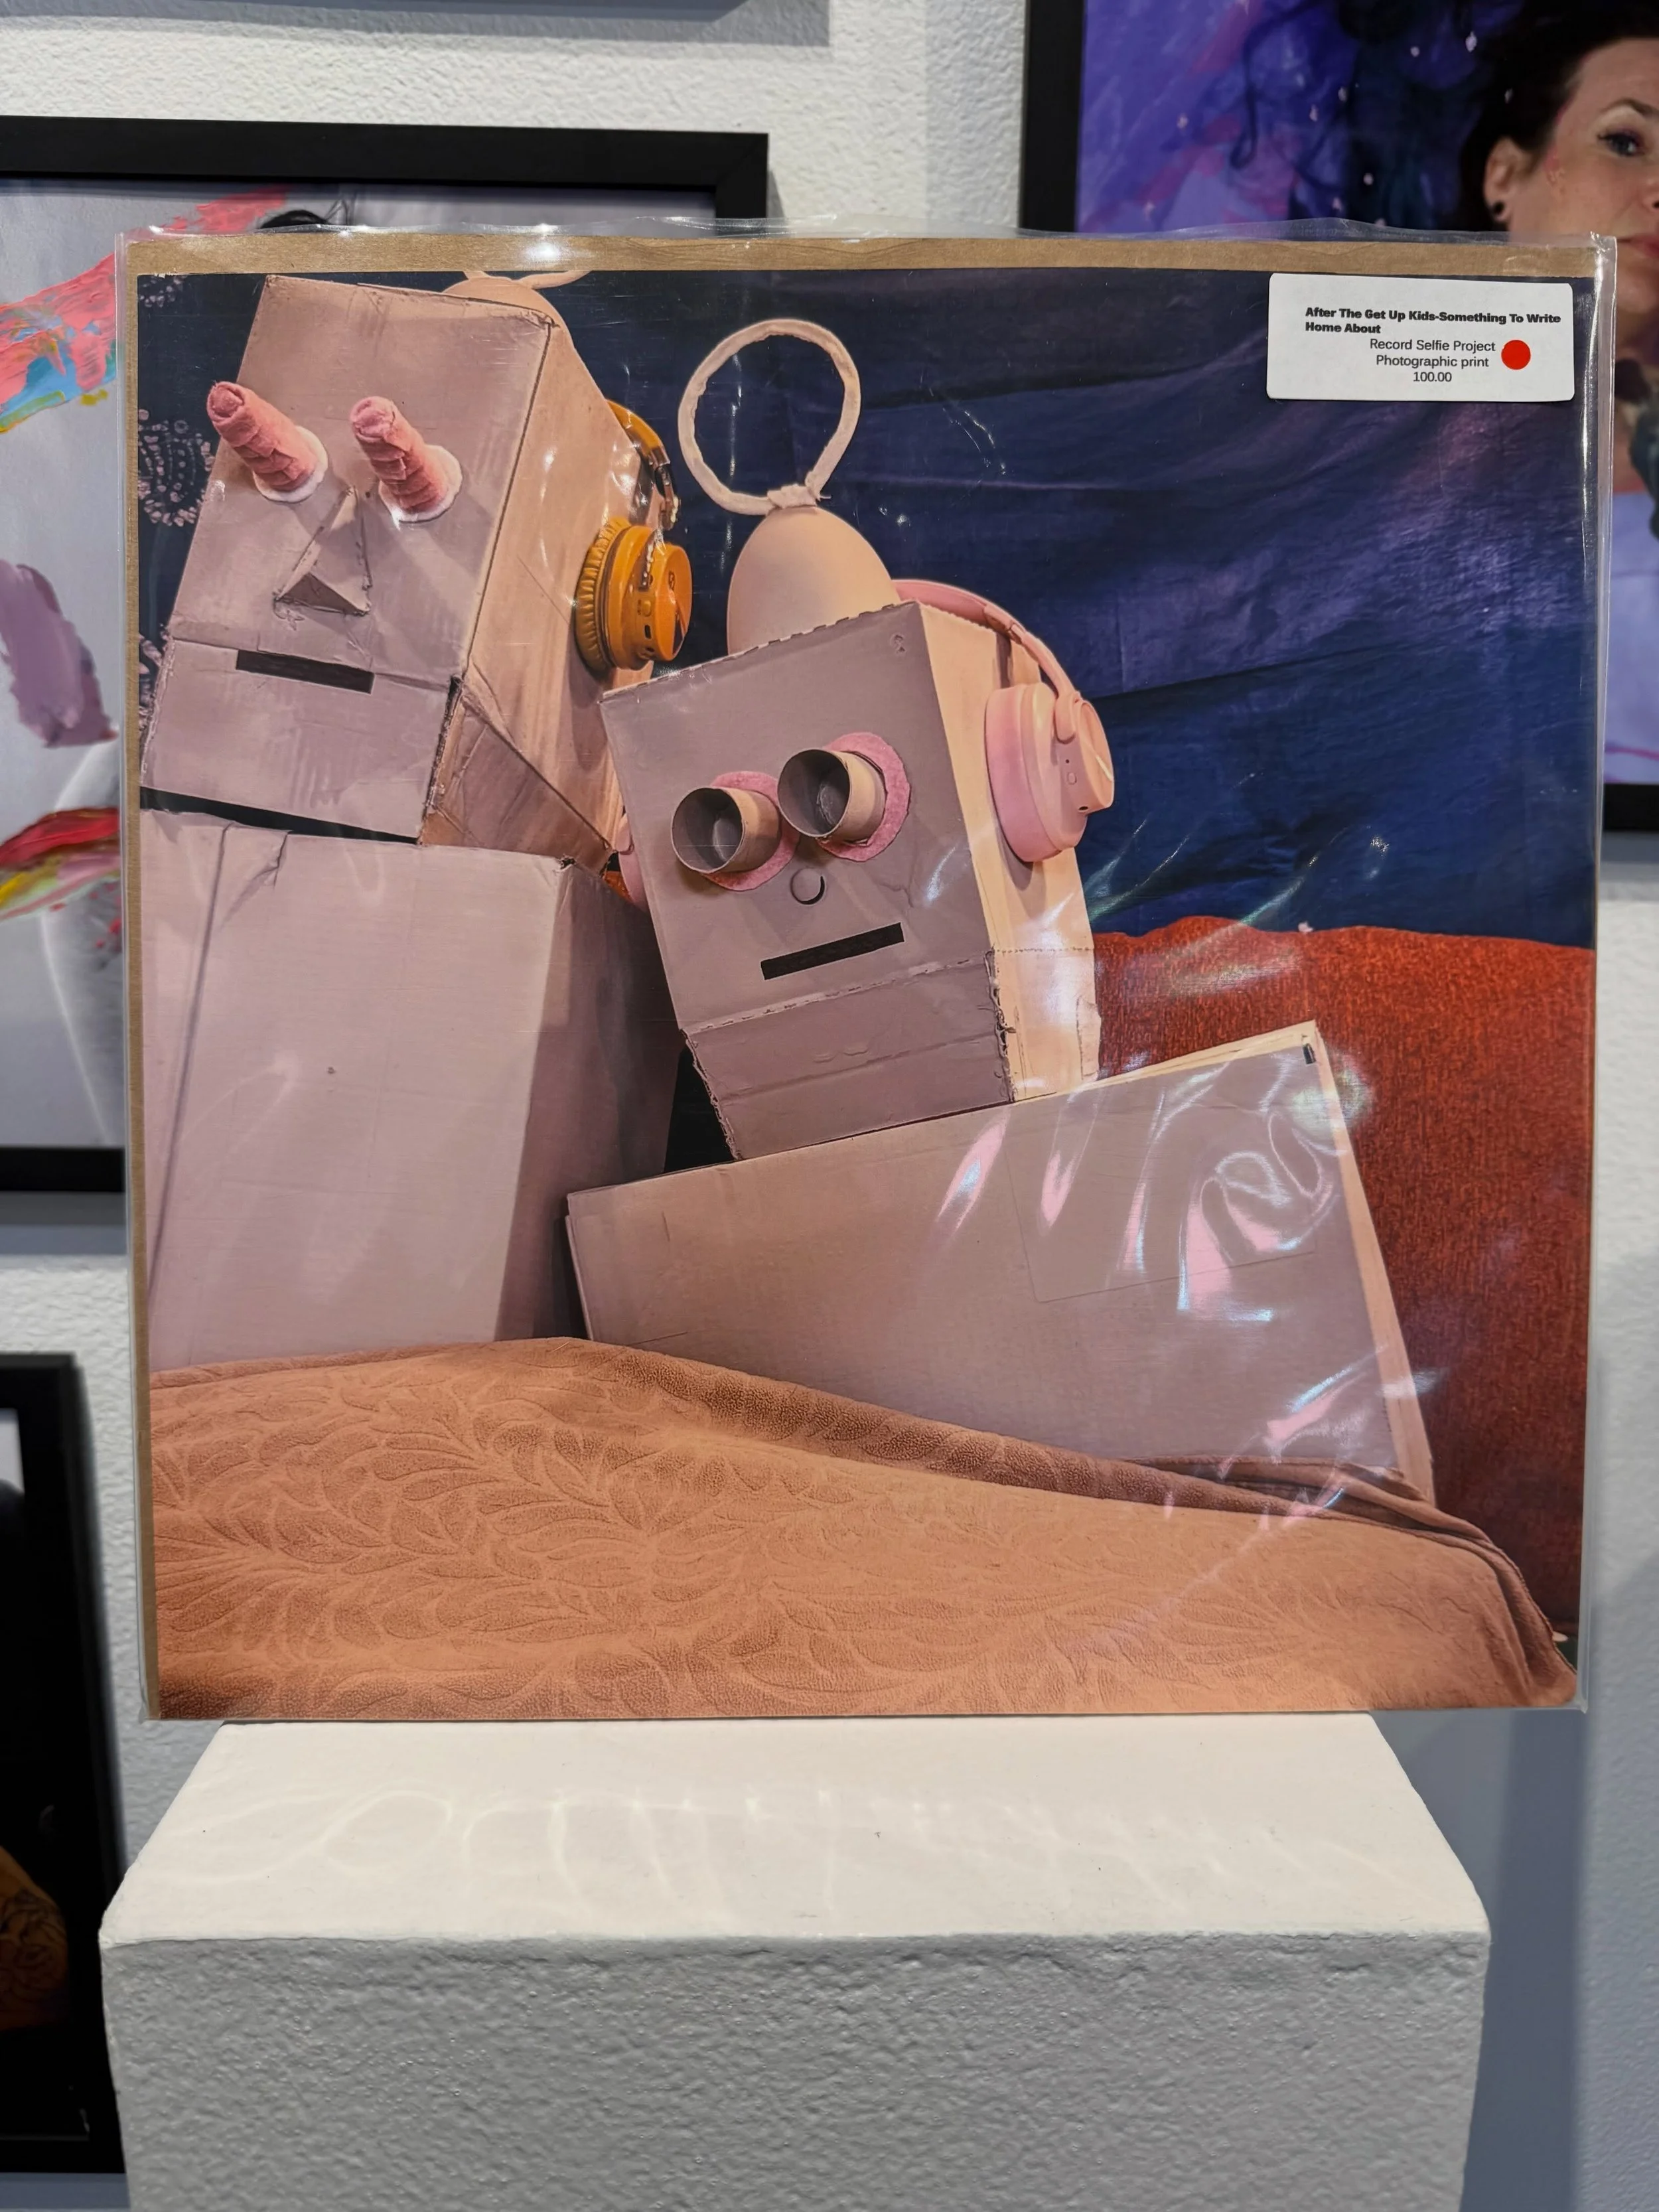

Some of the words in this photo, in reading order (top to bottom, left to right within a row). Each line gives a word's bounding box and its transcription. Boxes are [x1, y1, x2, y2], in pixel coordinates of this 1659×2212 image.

[1305, 307, 1336, 317] After
[1339, 309, 1362, 319] The
[1365, 309, 1386, 319] Get
[1389, 311, 1406, 322] Up
[1409, 311, 1506, 325] Kids-Something
[1509, 314, 1524, 323] To
[1526, 314, 1561, 323] Write
[1306, 322, 1342, 332] Home
[1344, 323, 1381, 333] About
[1370, 338, 1412, 349] Record
[1417, 340, 1449, 350] Selfie
[1454, 340, 1496, 354] Project
[1377, 355, 1457, 368] Photographic
[1461, 356, 1488, 369] print
[1413, 372, 1452, 382] 100.00
